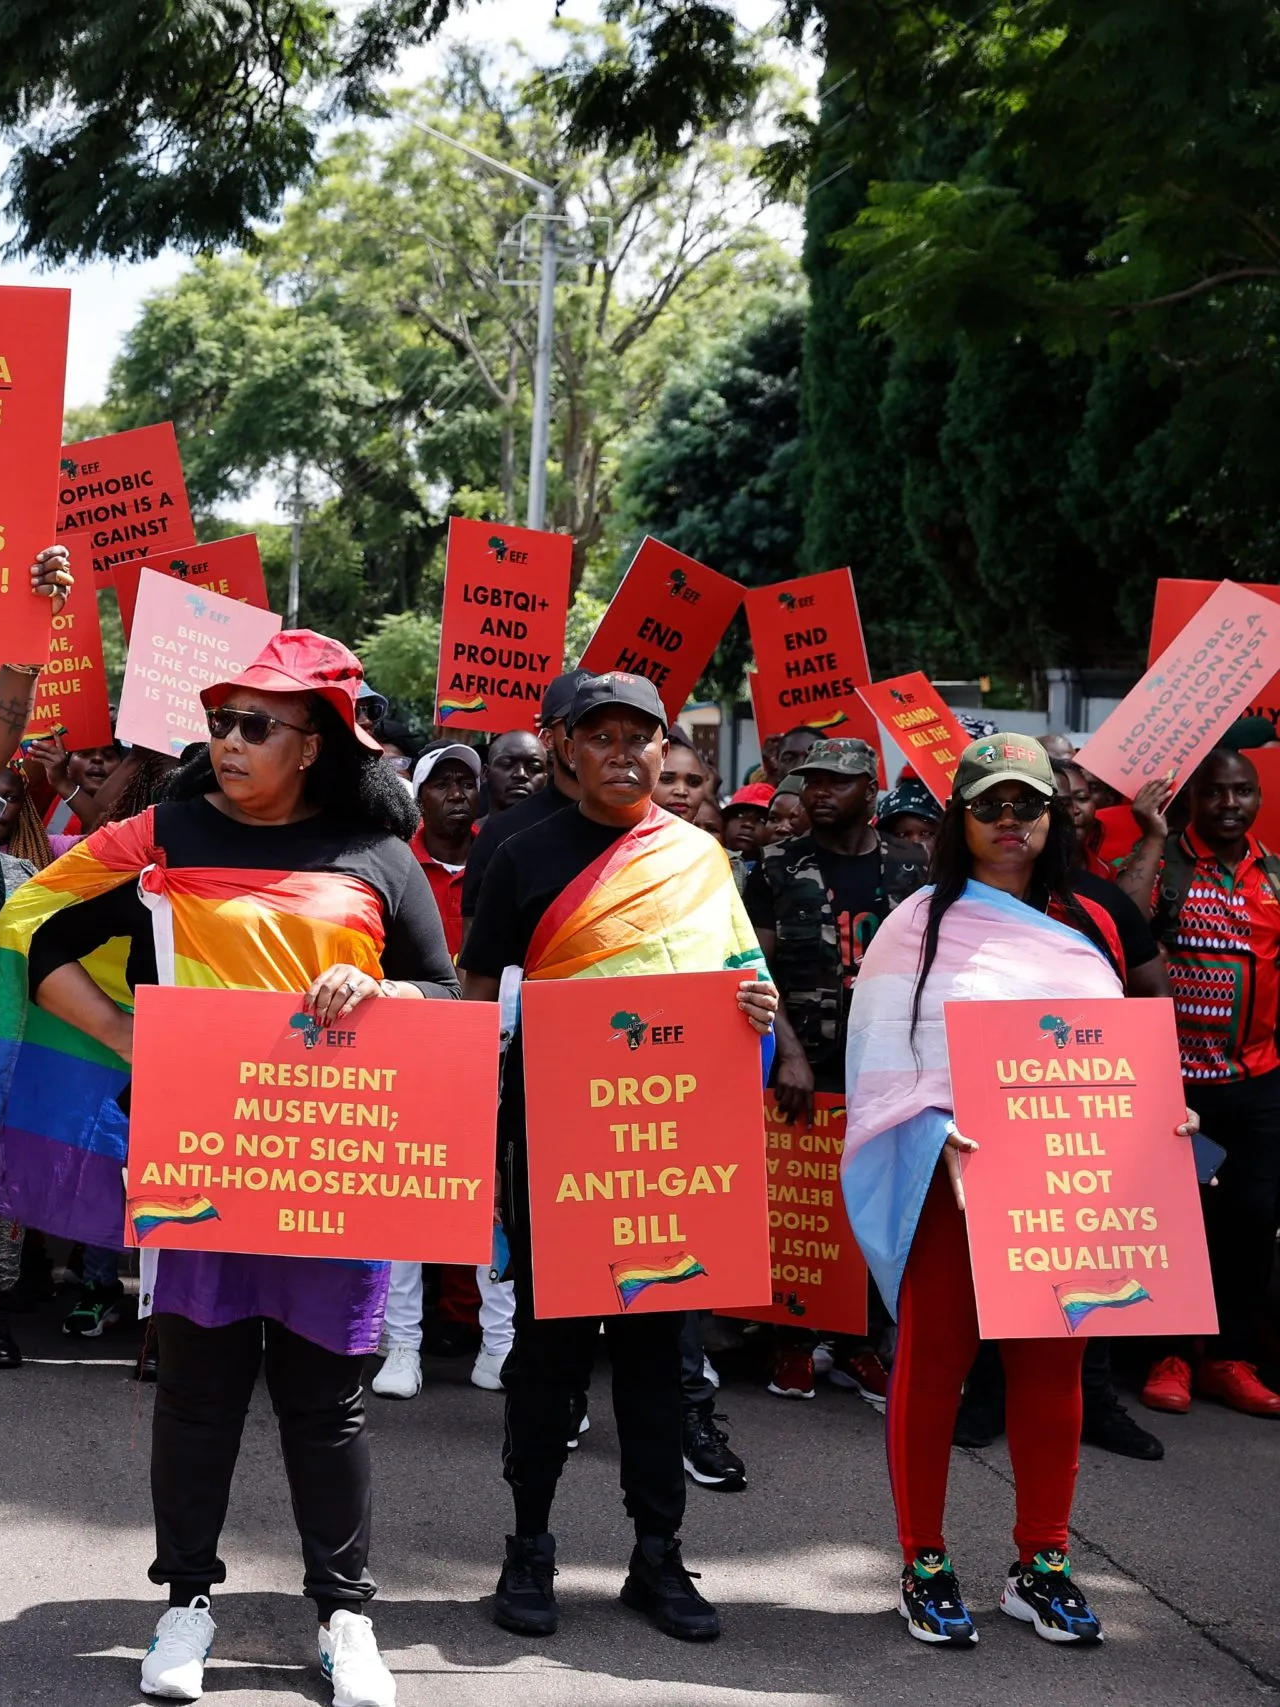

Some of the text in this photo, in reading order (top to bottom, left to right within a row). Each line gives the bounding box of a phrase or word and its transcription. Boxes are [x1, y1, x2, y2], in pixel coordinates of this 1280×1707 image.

[81, 462, 100, 475] EFF
[58, 471, 153, 506] OPHOBIC
[56, 492, 174, 532] LATION IS A
[93, 547, 149, 572] ANITY
[192, 562, 209, 574] EFF
[509, 551, 528, 562] EFF
[463, 584, 549, 612] LGBTQI+
[683, 588, 701, 603] EFF
[799, 595, 814, 606] EFF
[52, 614, 75, 630] OT
[210, 610, 231, 623] EFF
[480, 617, 527, 639] AND
[177, 625, 230, 652] BEING
[637, 617, 683, 652] END
[784, 627, 827, 651] END
[152, 635, 188, 655] GAY
[193, 649, 209, 663] IS
[454, 643, 551, 672] PROUDLY
[152, 652, 182, 672] THE
[614, 648, 671, 688] HATE
[785, 653, 837, 678] HATE
[1167, 657, 1182, 674] EFF
[39, 679, 81, 697] TRUE
[778, 678, 855, 708] CRIMES
[1118, 619, 1234, 753] HOMOPHOBIC
[1120, 613, 1261, 775] LEGISLATION IS A
[145, 686, 196, 713] IS THE
[1142, 718, 1192, 776] CRIME
[1195, 627, 1267, 714] AGAINST
[1172, 658, 1264, 765] HUMANITY
[166, 712, 209, 736] CRIM
[892, 707, 939, 729] UGANDA
[908, 725, 951, 748] KILL THE
[932, 749, 956, 765] BILL
[1004, 744, 1036, 764] EFF
[327, 1030, 356, 1046] EFF
[652, 1025, 683, 1043] EFF
[1075, 1029, 1103, 1043] EFF
[239, 1062, 397, 1092] PRESIDENT
[996, 1058, 1136, 1083] UGANDA
[590, 1074, 697, 1108] DROP
[234, 1098, 399, 1131] MUSEVENI;
[1007, 1095, 1133, 1120] KILL THE
[179, 1131, 447, 1167] DO NOT SIGN THE
[610, 1121, 678, 1152] THE
[799, 1135, 846, 1154] AND
[1045, 1133, 1106, 1157] BILL
[140, 1162, 482, 1201] ANTI-HOMOSEXUALITY
[555, 1164, 738, 1202] ANTI-GAY
[787, 1161, 838, 1180] EING
[1046, 1170, 1112, 1195] NOT
[768, 1185, 833, 1207] BETWE
[278, 1209, 345, 1235] BILL!
[613, 1214, 686, 1246] BILL
[769, 1212, 829, 1232] CHOO
[1008, 1207, 1158, 1233] THE GAYS
[782, 1239, 840, 1260] MUST
[1007, 1245, 1169, 1272] EQUALITY!
[771, 1264, 822, 1285] PEOP
